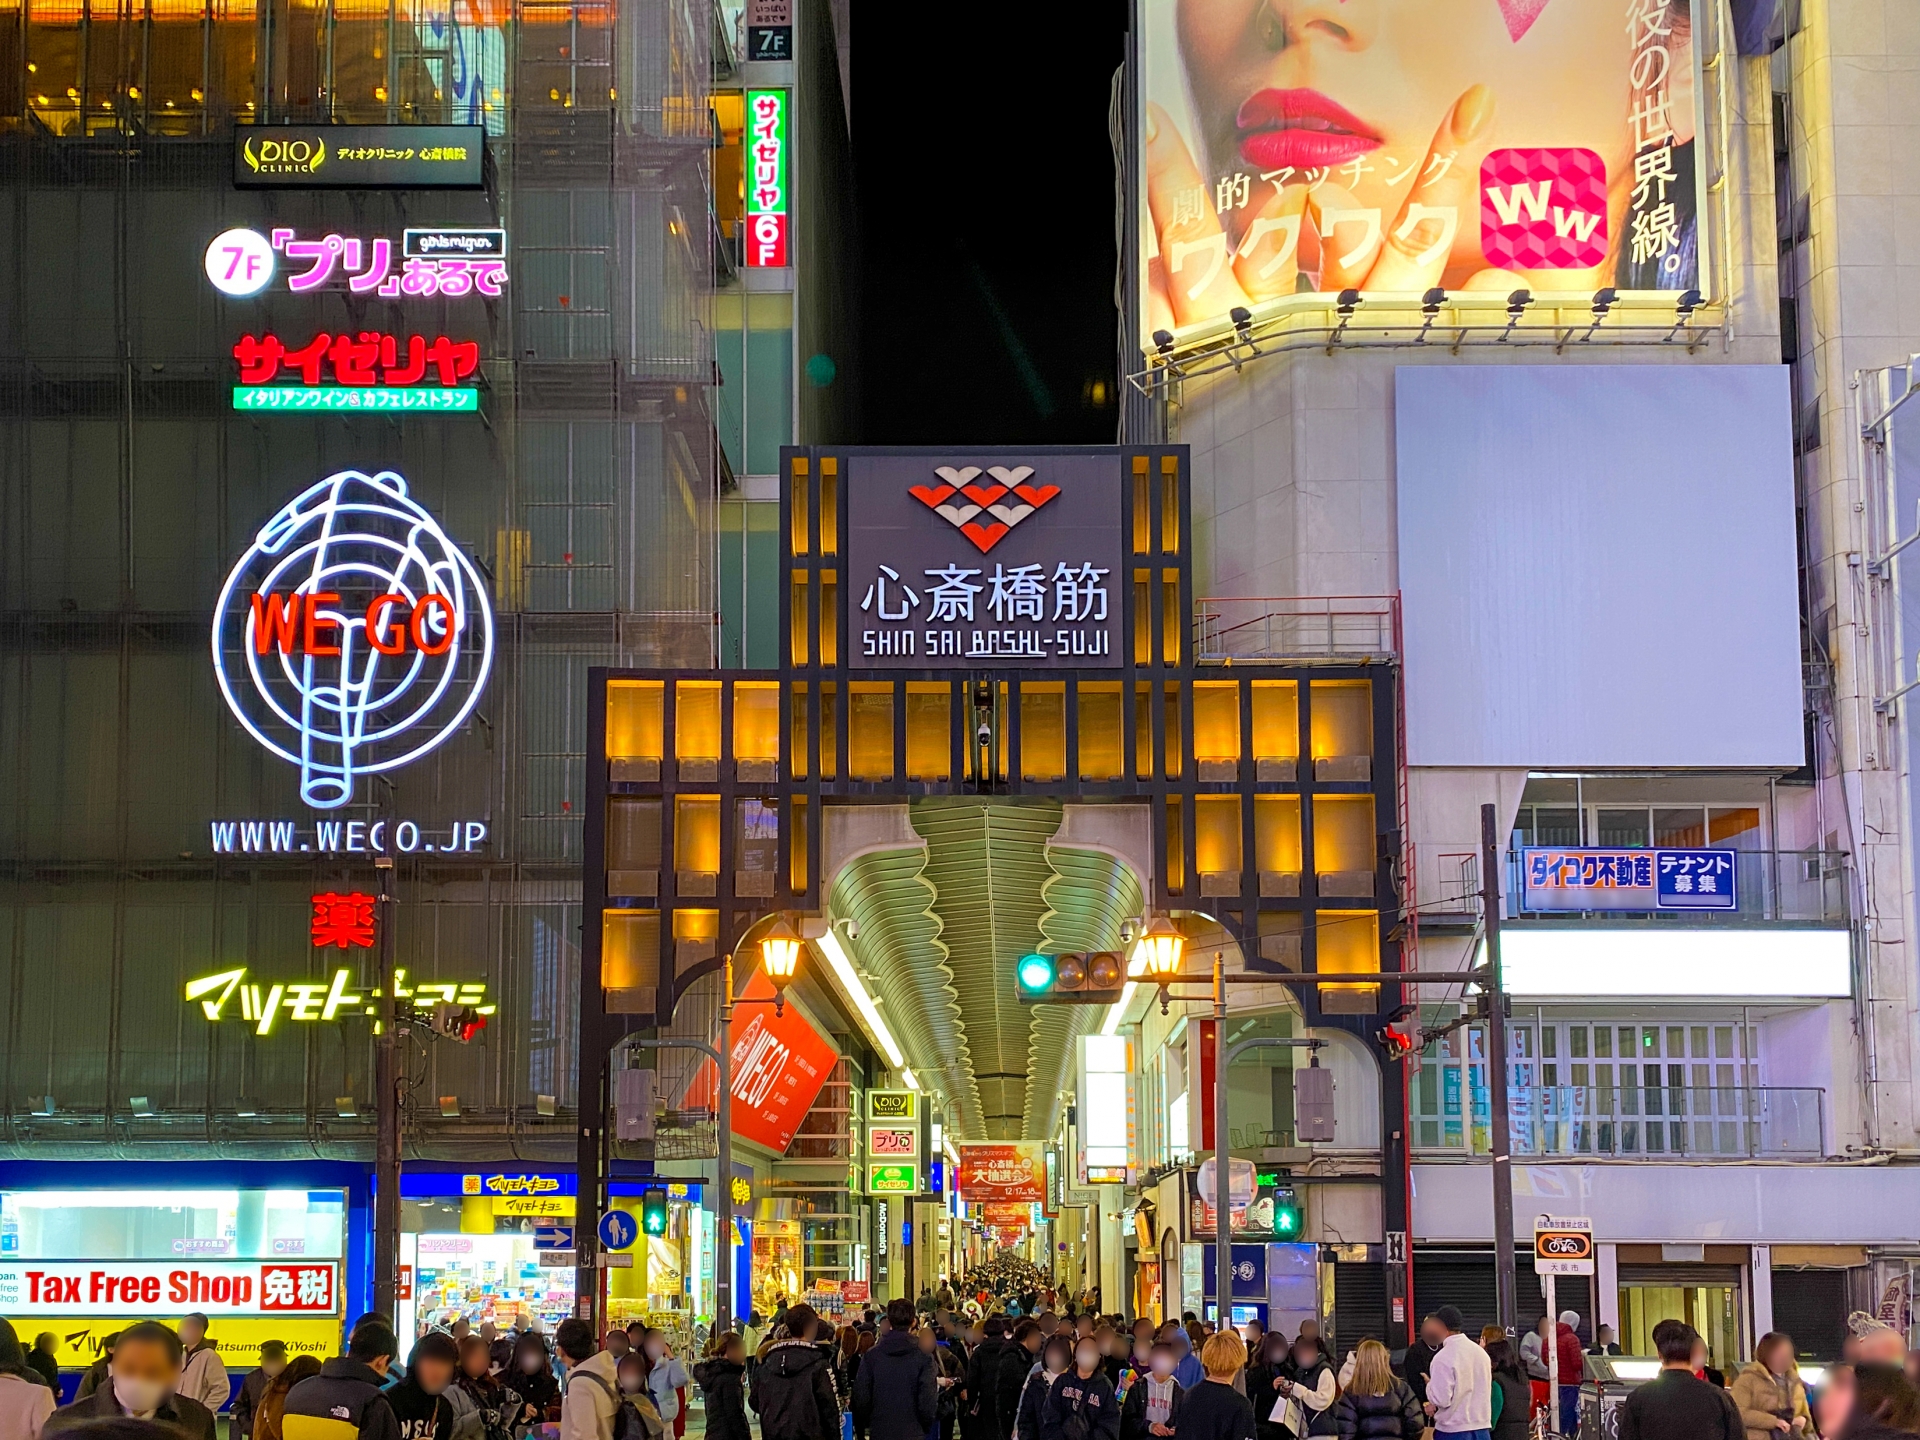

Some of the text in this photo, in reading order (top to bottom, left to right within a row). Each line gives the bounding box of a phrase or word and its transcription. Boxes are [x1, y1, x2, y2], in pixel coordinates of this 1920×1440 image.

[758, 30, 784, 51] 7F
[260, 141, 311, 162] DIO
[336, 147, 467, 161] ディオクリニック 心斎橋院
[755, 97, 779, 208] サイゼリヤ
[260, 164, 308, 173] CLINIC
[755, 215, 779, 266] 6F
[1170, 201, 1459, 301] ワクワク
[222, 246, 261, 281] 7F
[400, 258, 508, 296] あるで
[233, 332, 479, 386] サイゼリヤ
[860, 562, 1110, 623] 心斎橋筋
[925, 630, 961, 655] SAI
[1531, 855, 1652, 887] ダイコク不動産
[1660, 856, 1730, 875] テナント
[1674, 875, 1717, 893] 募集
[311, 892, 375, 949] 薬
[880, 1097, 901, 1107] DIO
[487, 1175, 559, 1193] マツモトキヨシ
[505, 1199, 563, 1214] マツモトキヨシ
[428, 1238, 468, 1247] ハンドクリーム
[879, 1202, 887, 1255] McDonald's
[25, 1269, 330, 1306] Tax Free Shop 免税
